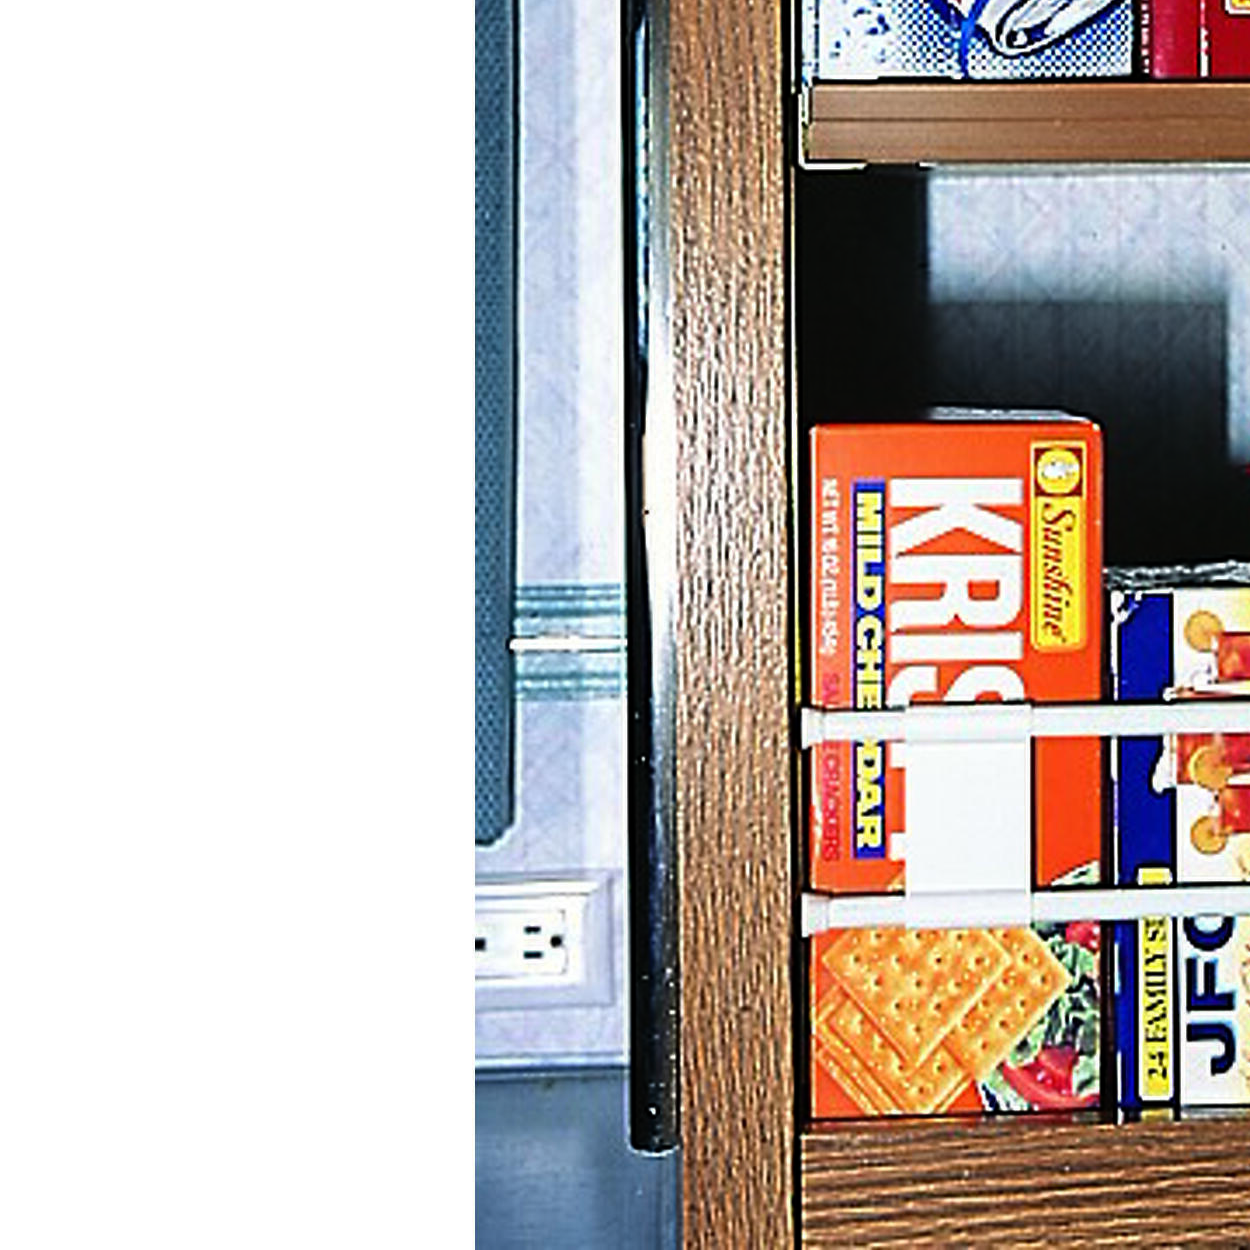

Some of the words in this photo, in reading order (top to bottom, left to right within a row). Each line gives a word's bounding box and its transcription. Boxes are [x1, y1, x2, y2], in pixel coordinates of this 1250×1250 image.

[855, 491, 883, 608] MILD
[1041, 502, 1077, 640] Sunshine
[855, 614, 883, 848] CHEDAR
[1146, 947, 1168, 1042] FAMILY
[1146, 1051, 1168, 1080] 24
